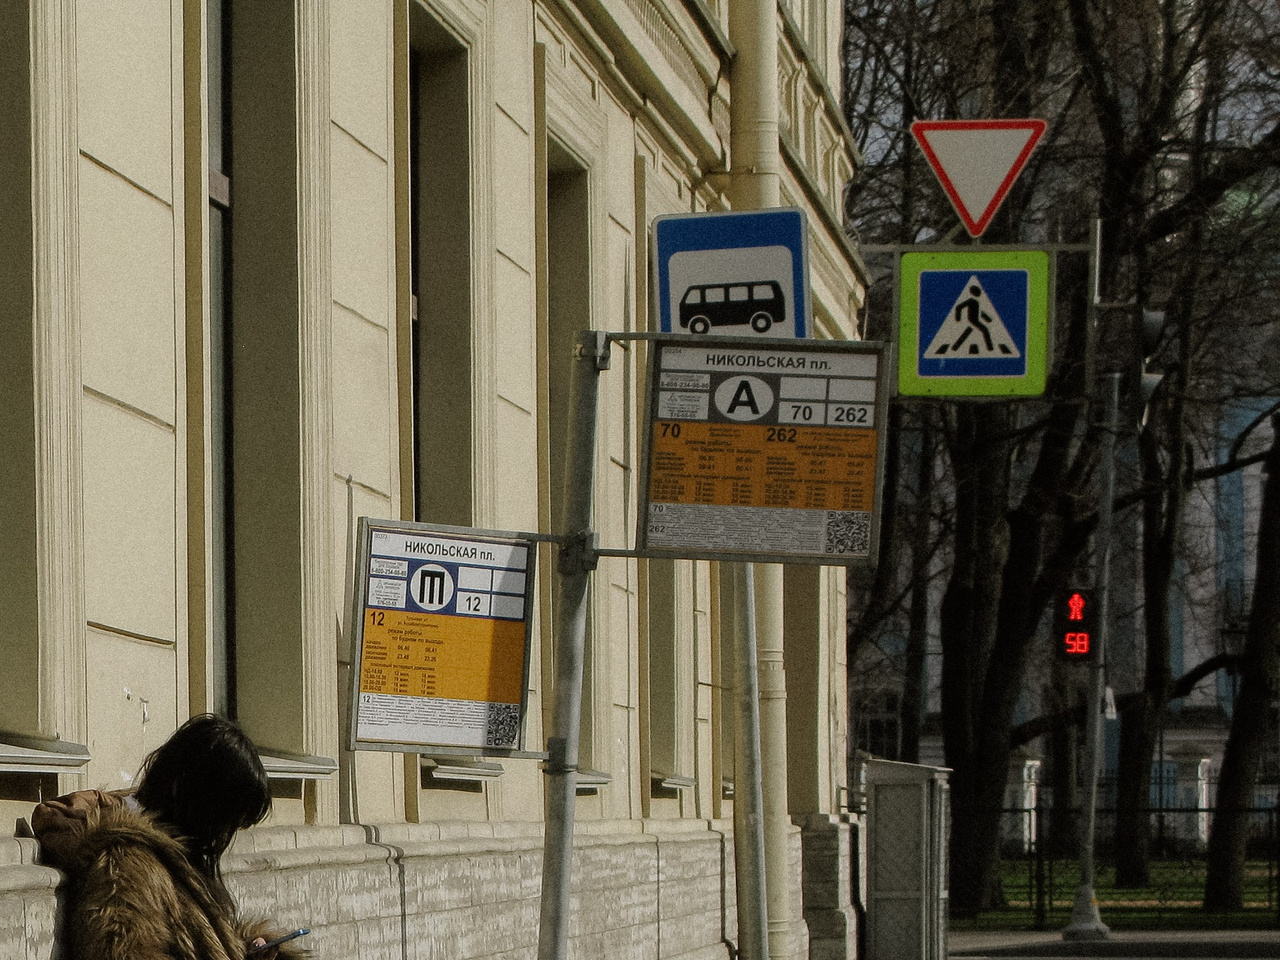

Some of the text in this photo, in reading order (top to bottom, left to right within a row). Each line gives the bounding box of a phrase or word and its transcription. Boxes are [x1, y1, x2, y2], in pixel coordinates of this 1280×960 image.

[706, 354, 832, 370] НИКОЛЬСКАЯ пл.
[791, 405, 813, 421] 70
[834, 407, 868, 423] 262
[661, 423, 681, 438] 70
[766, 427, 797, 443] 262
[653, 505, 664, 513] 70
[649, 525, 665, 533] 262
[405, 541, 496, 562] НИКОЛЬСКАЯ пл.
[466, 596, 481, 612] 12
[370, 611, 385, 627] 12
[1065, 632, 1089, 653] 58
[362, 695, 371, 703] 12
